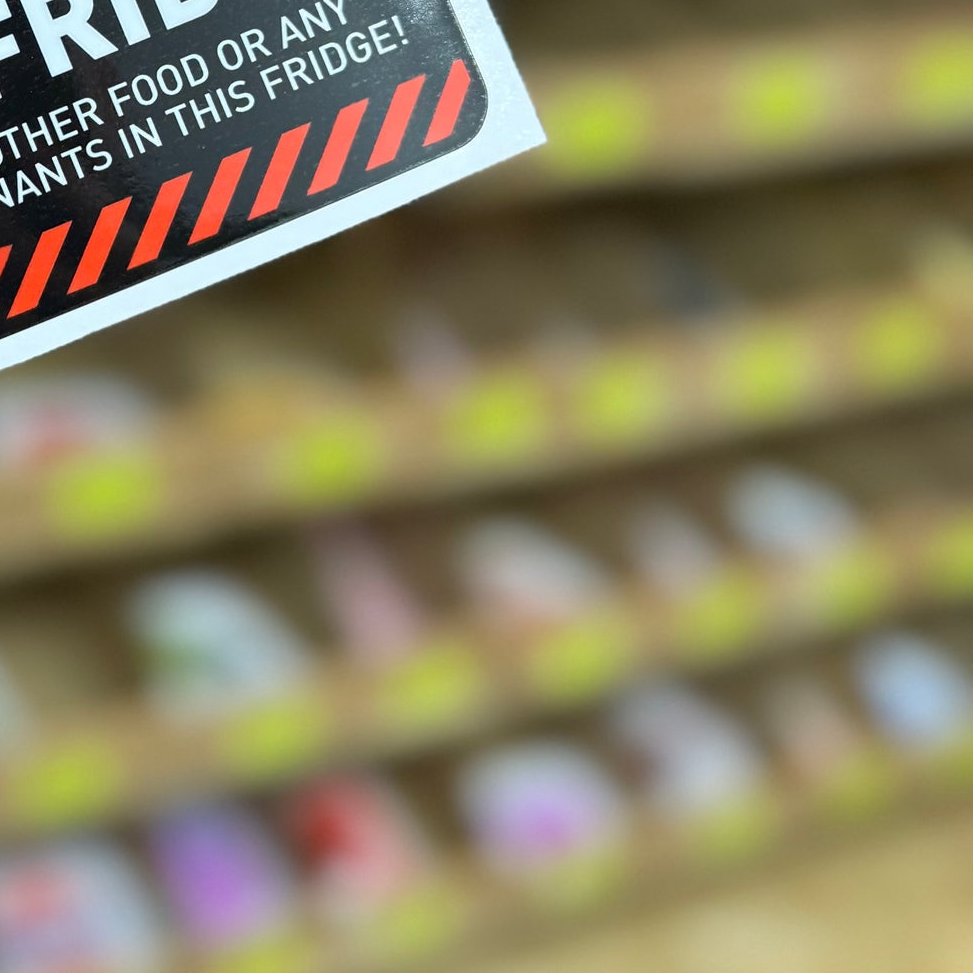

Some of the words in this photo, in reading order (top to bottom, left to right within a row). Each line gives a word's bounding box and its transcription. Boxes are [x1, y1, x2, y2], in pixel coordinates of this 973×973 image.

[107, 53, 209, 118] FOOD
[216, 28, 273, 71] OR
[117, 116, 163, 159] IN
[164, 80, 255, 137] THIS
[259, 14, 409, 100] FRIDGE!
